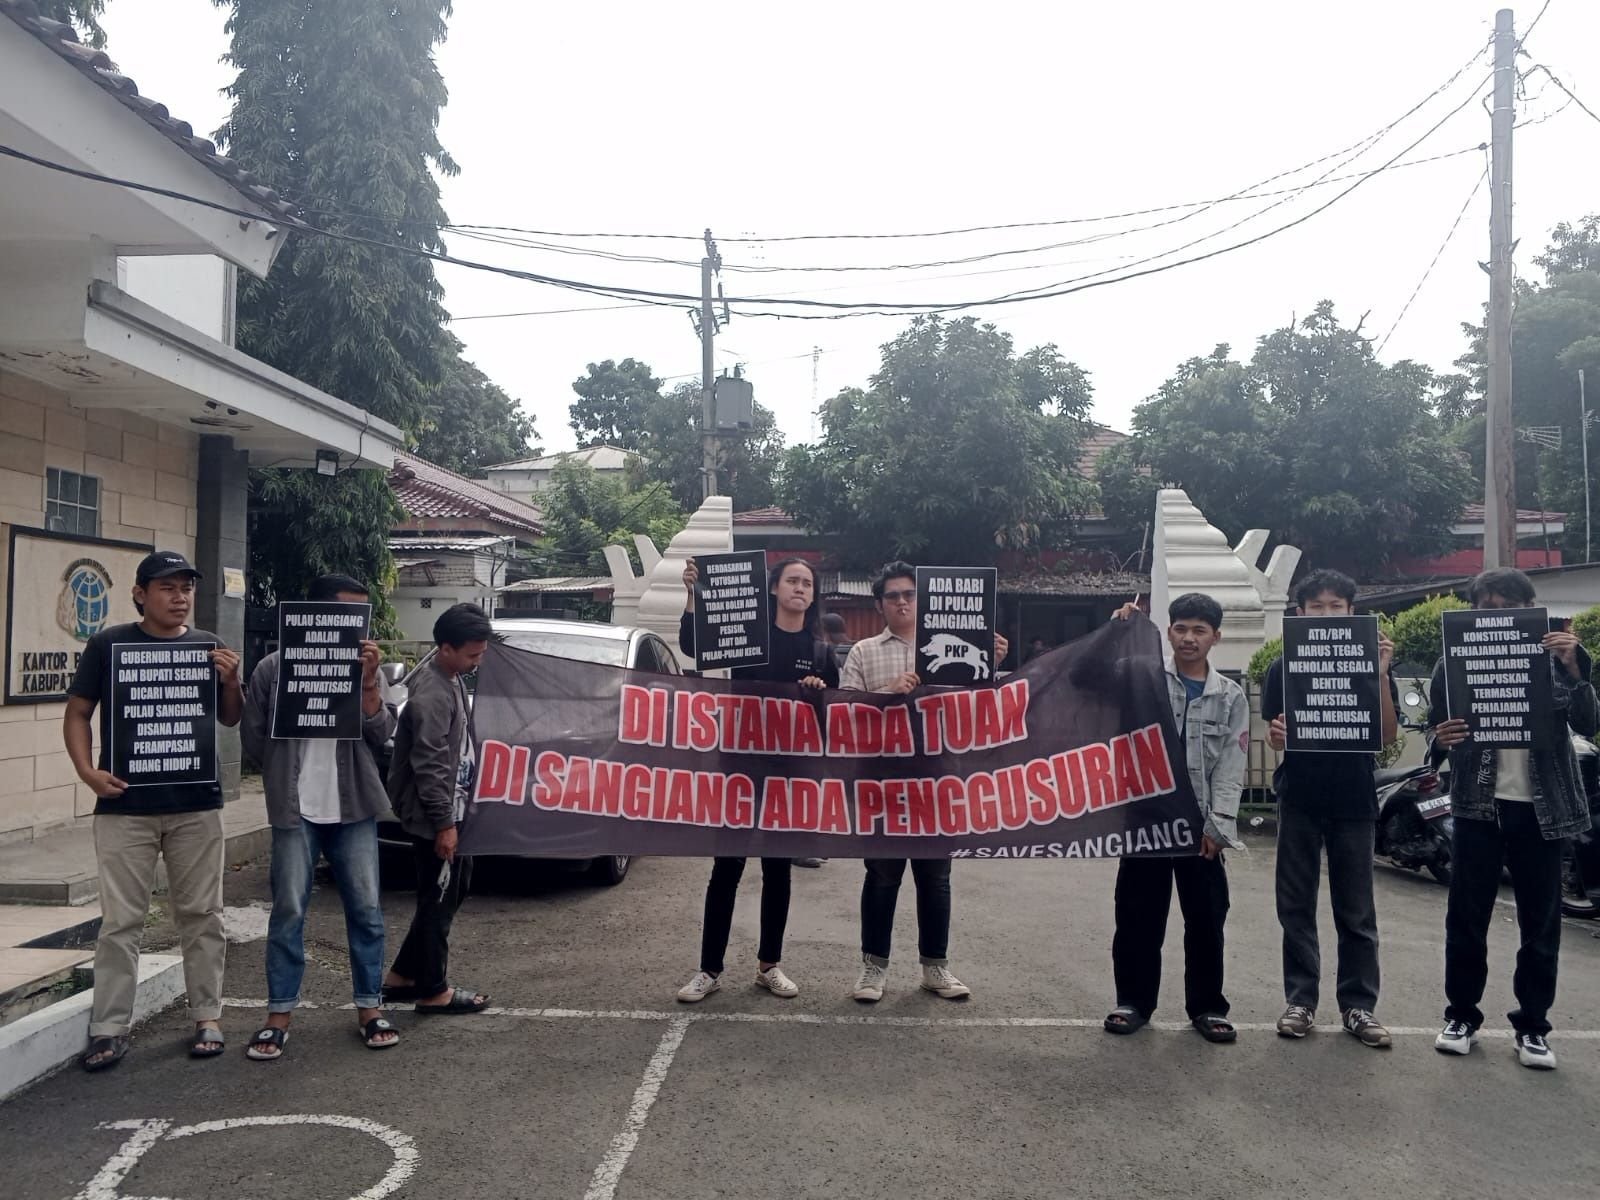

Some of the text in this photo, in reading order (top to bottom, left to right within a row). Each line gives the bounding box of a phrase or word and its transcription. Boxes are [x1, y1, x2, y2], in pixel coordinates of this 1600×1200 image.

[710, 575, 750, 586] PUTUSAN MK
[929, 578, 984, 594] ADA BABI
[702, 591, 710, 599] NO
[712, 590, 717, 599] 3
[718, 588, 738, 598] TAHUN
[706, 599, 758, 612] TIDAK BOLEH ADA
[930, 596, 983, 612] DI PULAU
[286, 615, 363, 627] PULAU SANGIANG
[722, 614, 729, 622] DI
[730, 611, 756, 622] WILAYAH
[924, 614, 987, 630] SANGIANG.
[1475, 616, 1514, 628] AMANAT
[305, 631, 340, 643] ADALAH
[1308, 628, 1352, 640] ATR/BPN
[1463, 630, 1520, 642] KONSTITUSI
[719, 636, 747, 647] LAUT DAN
[285, 648, 326, 659] ANUGRAH
[702, 649, 743, 661] PULAU-PULAU
[945, 645, 968, 658] PKP
[1298, 645, 1364, 656] HARUS TEGAS
[1450, 644, 1544, 657] PENJAJAHAN DIATAS
[23, 652, 67, 671] KANTOR
[121, 650, 208, 664] GUBERNUR BANTEN
[293, 664, 350, 676] TIDAK UNTUK
[1289, 661, 1374, 673] MENOLAK SEGALA
[1466, 658, 1530, 670] DUNIA HARUS
[119, 668, 210, 682] DAN BUPATI SERANG
[1467, 673, 1531, 684] DIHAPUSKAN.
[23, 673, 74, 692] KABUPAT
[288, 681, 352, 693] DI PRIVATISASI
[1312, 678, 1351, 689] BENTUK
[131, 686, 199, 700] DICARI WARGA
[1473, 688, 1526, 699] TERMASUK
[307, 698, 328, 709] ATAU
[1306, 694, 1357, 706] INVESTASI
[124, 704, 205, 718] PULAU SANGIANG.
[1472, 702, 1529, 713] PENJAJAHAN
[298, 714, 336, 726] DIJUAL !!
[618, 684, 668, 748] DI
[672, 691, 823, 757] ISTANA
[825, 702, 915, 758] ADA
[1294, 711, 1371, 723] YANG MERUSAK
[1480, 717, 1523, 727] DI PULAU
[137, 722, 192, 736] DISANA ADA
[1297, 727, 1369, 739] LINGKUNGAN !!
[1474, 731, 1531, 742] SANGIANG !!
[134, 739, 195, 754] PERAMPASAN
[129, 757, 200, 773] RUANG HIDUP !!
[473, 722, 1176, 837] DI SANGIANG ADA PENGGUSURAN
